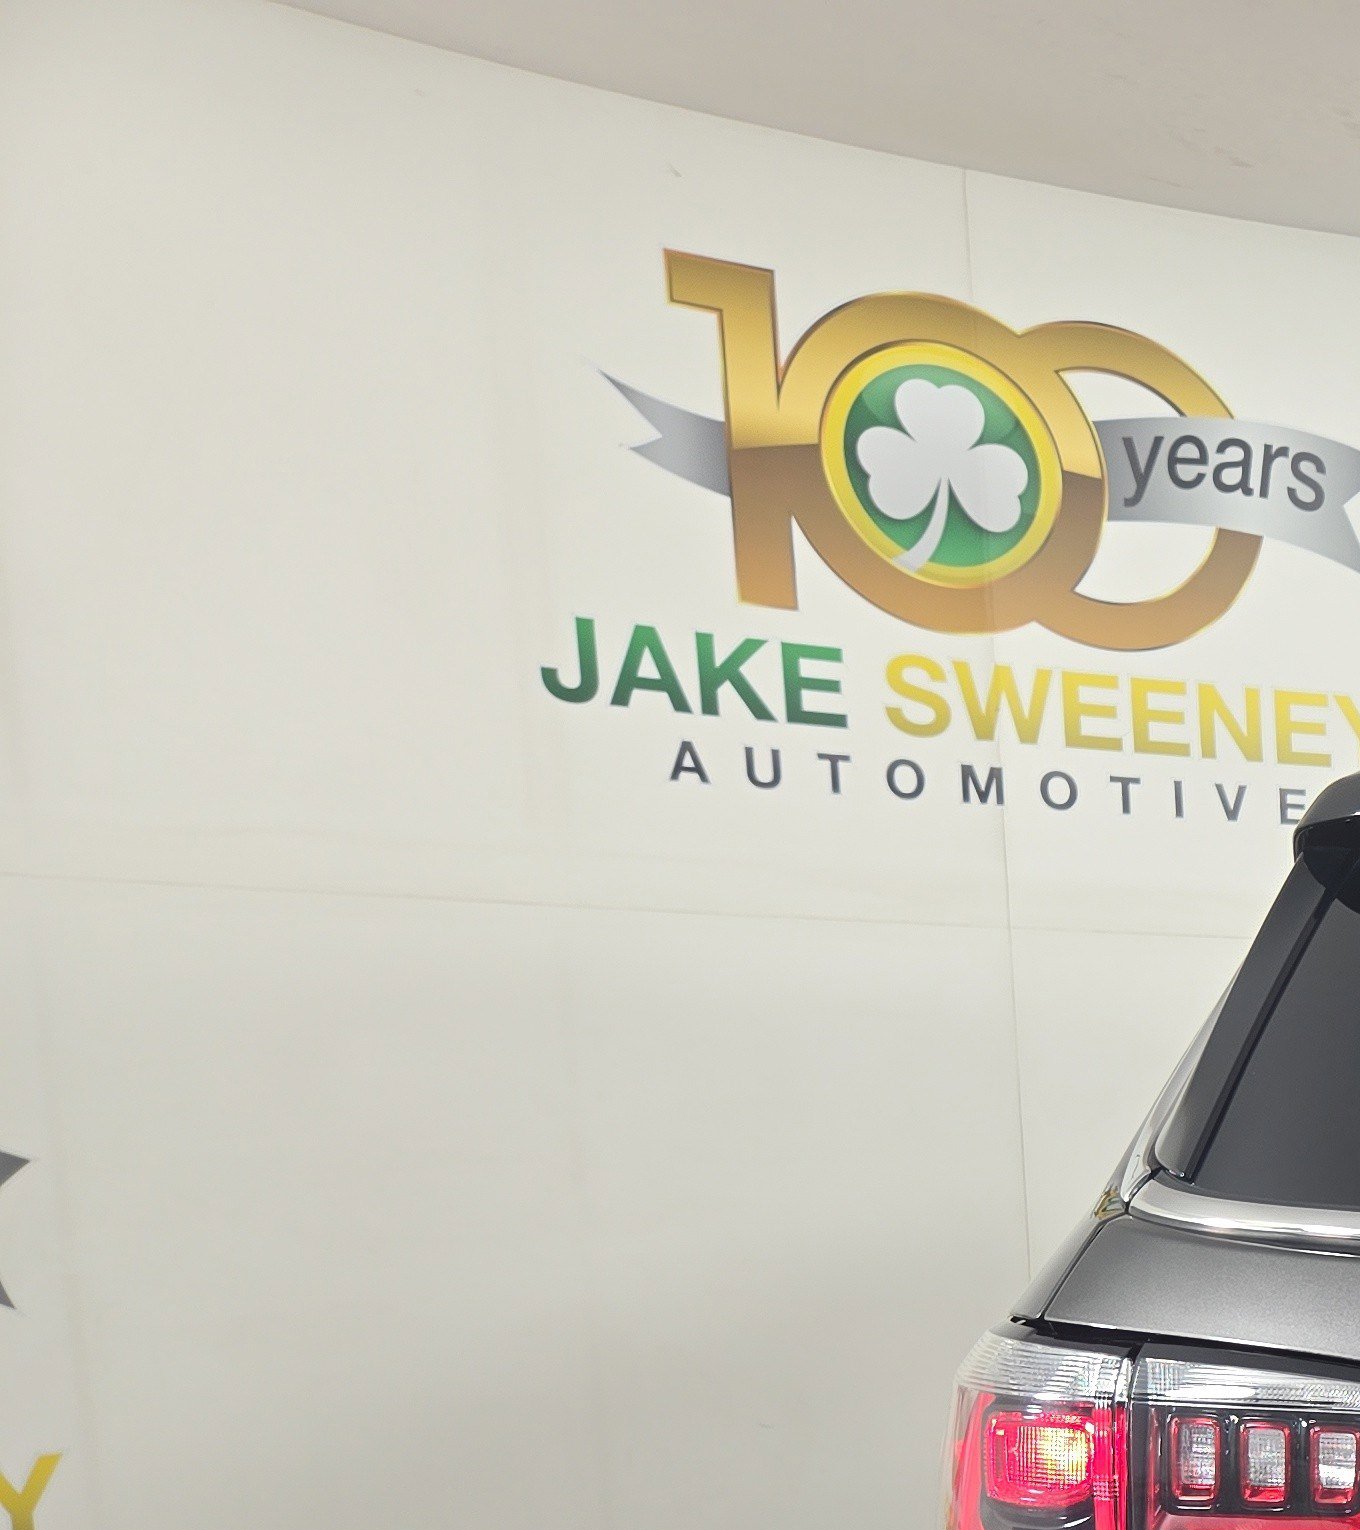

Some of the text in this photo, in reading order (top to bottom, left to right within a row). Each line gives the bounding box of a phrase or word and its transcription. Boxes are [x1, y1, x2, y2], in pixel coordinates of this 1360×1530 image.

[663, 248, 1262, 651] 100
[1121, 432, 1327, 512] years
[540, 617, 848, 729] JAKE
[670, 740, 1306, 825] AUTOMOTIVE
